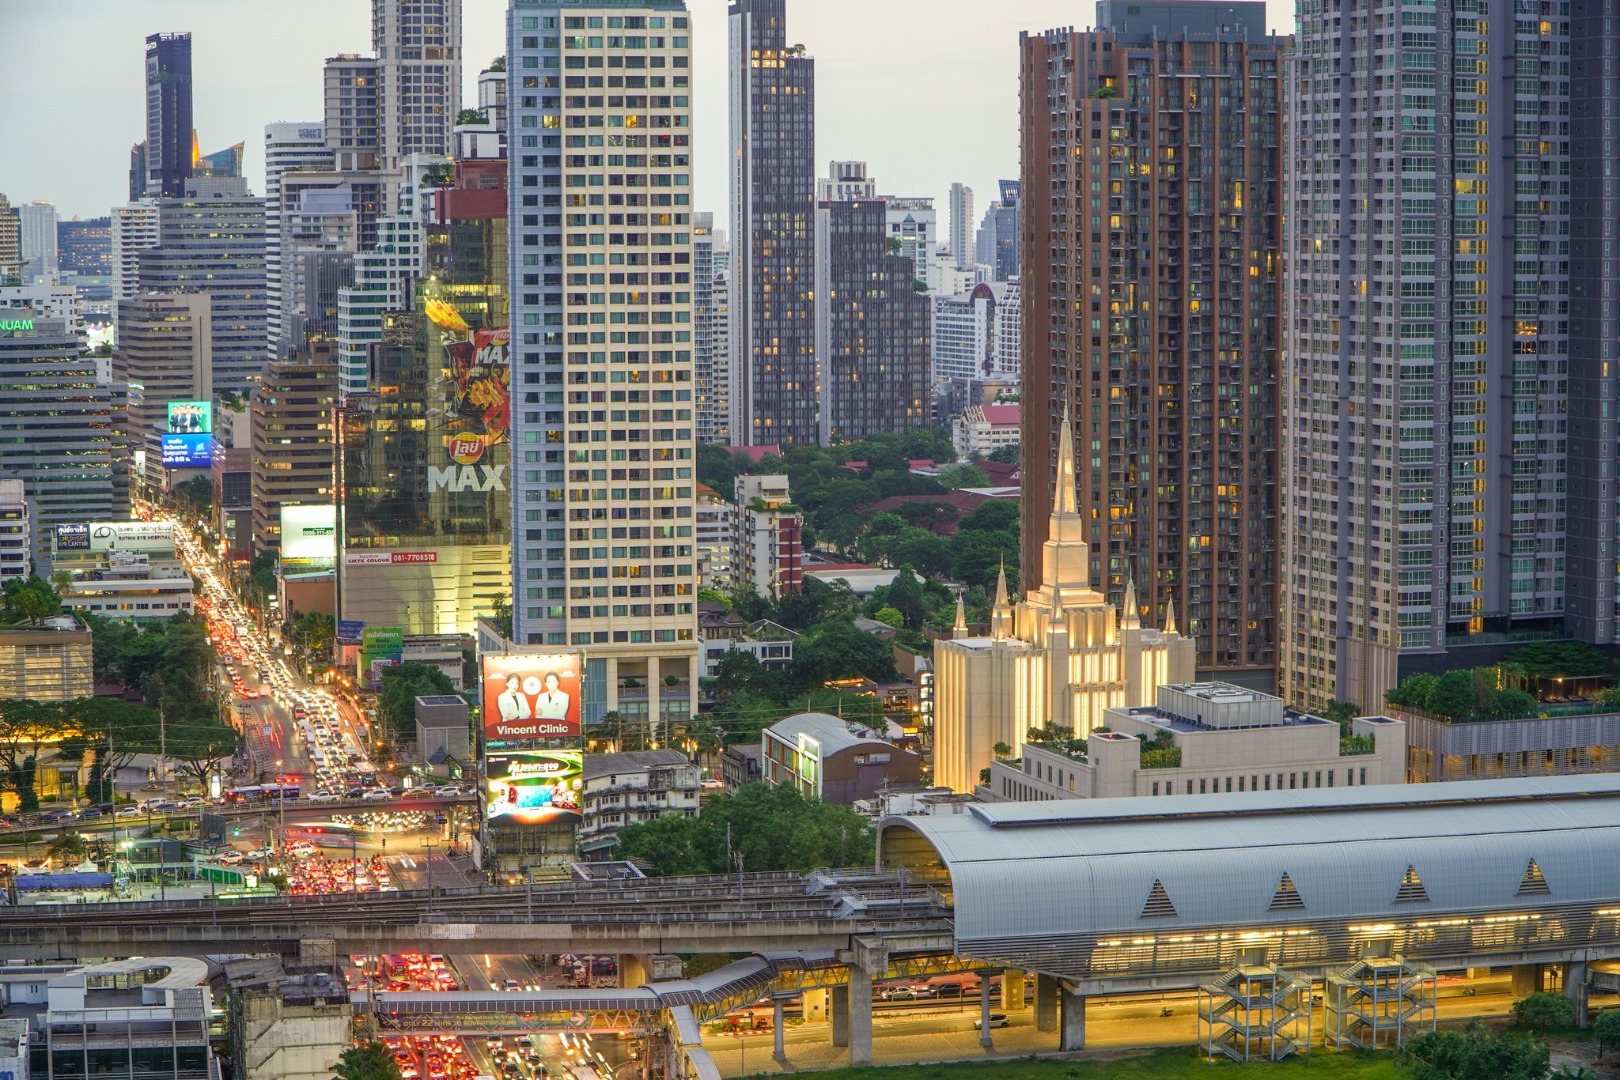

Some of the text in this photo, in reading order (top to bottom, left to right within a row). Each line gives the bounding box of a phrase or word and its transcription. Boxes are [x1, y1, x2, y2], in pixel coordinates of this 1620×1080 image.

[428, 465, 506, 492] MAX
[497, 724, 568, 734] Vincent Clinic
